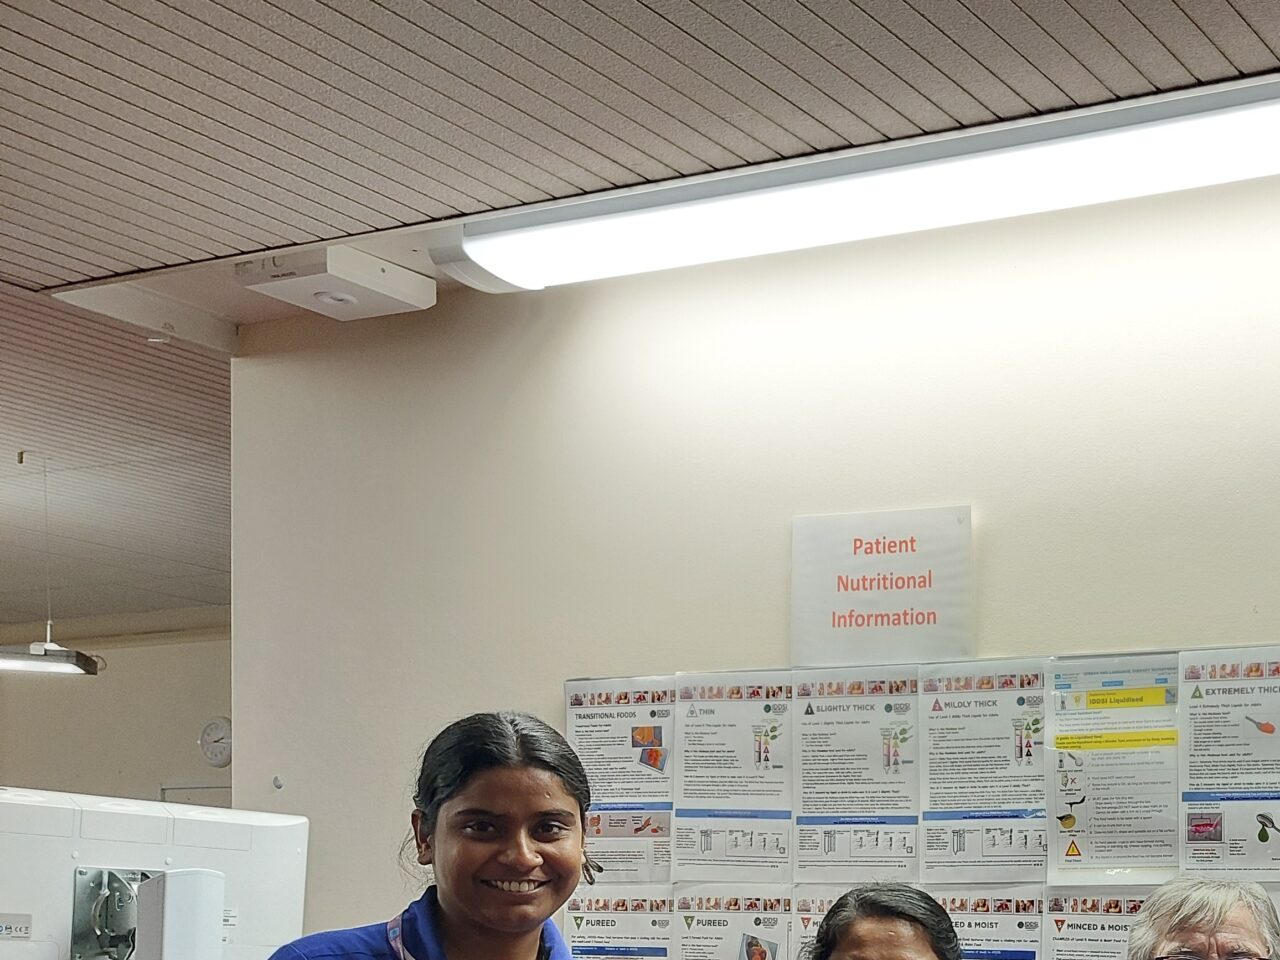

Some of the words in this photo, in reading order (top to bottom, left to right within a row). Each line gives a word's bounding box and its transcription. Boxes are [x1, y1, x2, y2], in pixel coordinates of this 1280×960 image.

[853, 536, 917, 556] Patient
[837, 569, 933, 592] Nutritional
[832, 608, 937, 629] Information
[1205, 687, 1256, 696] EXTREMELY
[816, 704, 851, 713] SLIGHTLY
[944, 700, 972, 709] MILDLY
[973, 699, 998, 708] THICK
[575, 712, 616, 720] TRANSITIONAL
[616, 711, 637, 719] FOODS
[585, 919, 617, 927] PUREED
[696, 919, 729, 927] PUREED
[974, 921, 999, 929] MOIST
[1066, 923, 1098, 931] MINCED
